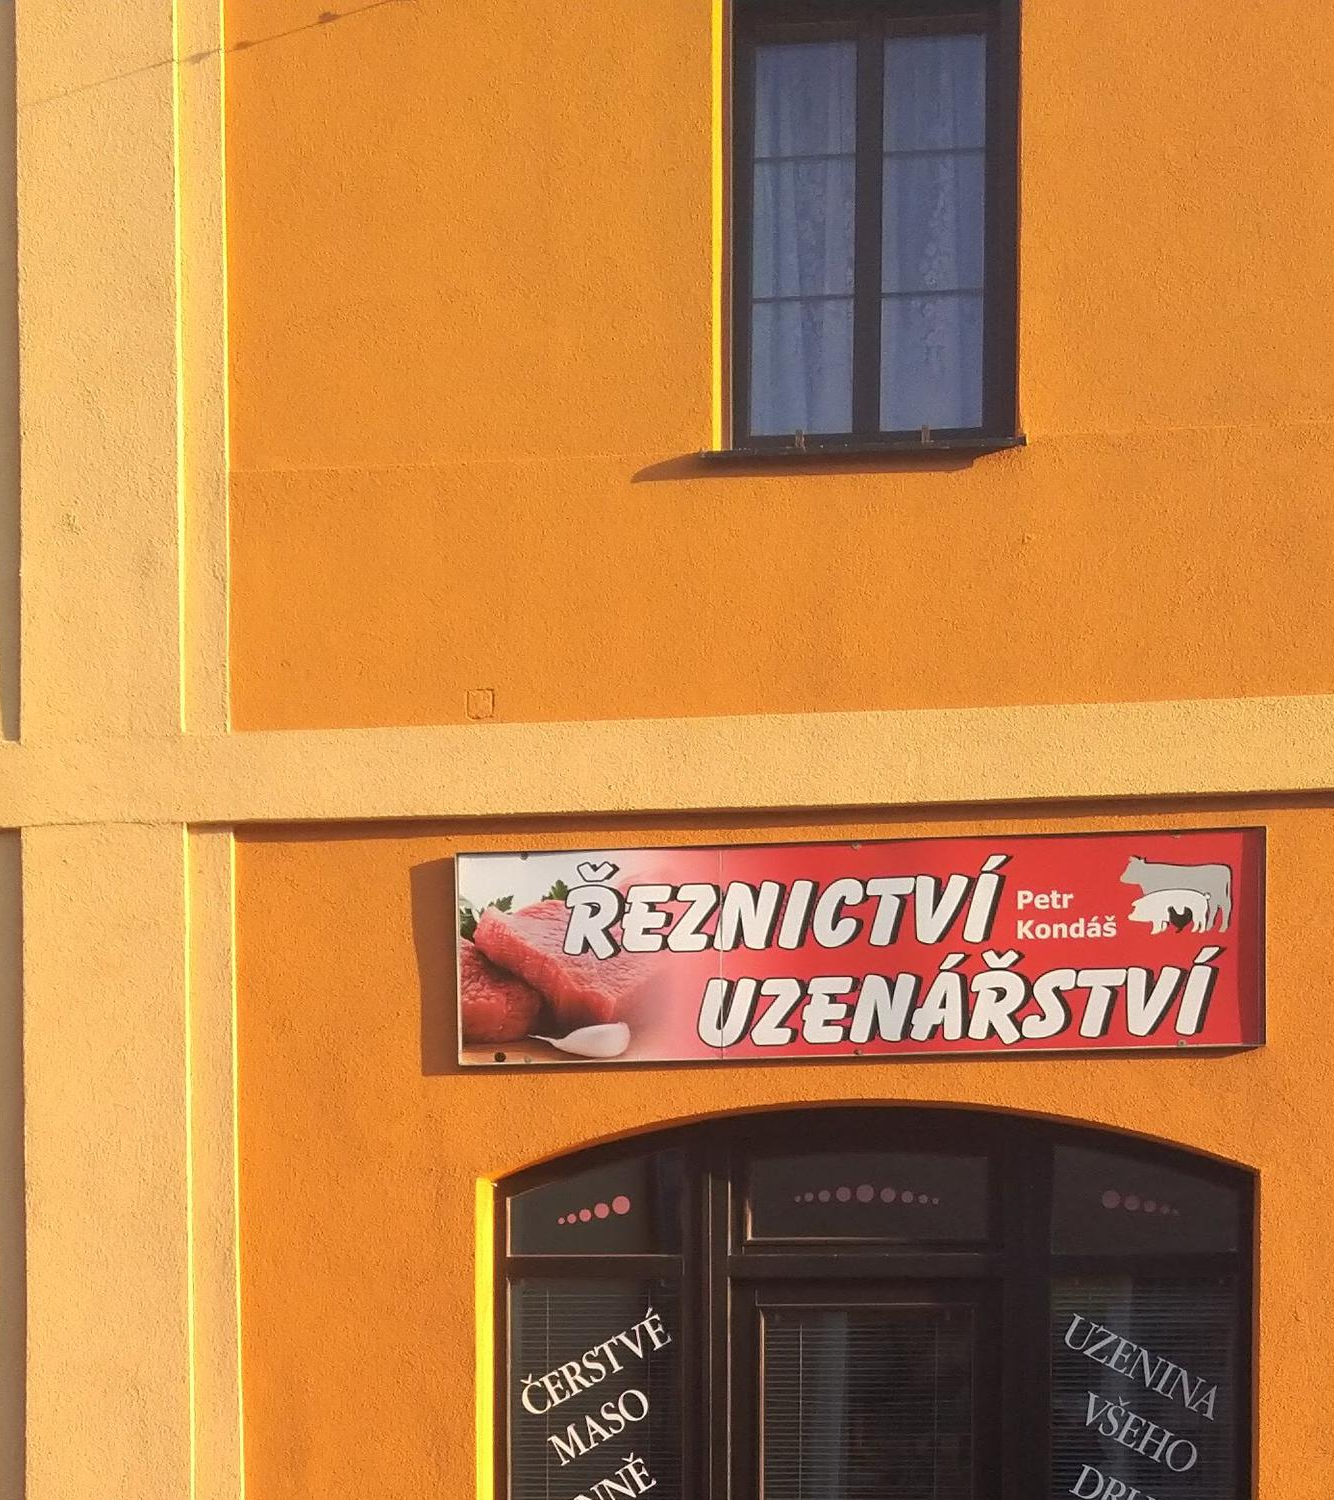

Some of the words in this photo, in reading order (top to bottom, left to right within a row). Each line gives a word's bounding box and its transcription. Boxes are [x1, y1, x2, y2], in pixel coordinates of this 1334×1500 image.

[562, 855, 1013, 961] ŘEZNICTVÍ
[1017, 888, 1075, 910] Petr
[1017, 916, 1117, 940] Kondáš
[697, 945, 1222, 1048] UZENÁŘSTVÍ
[520, 1306, 672, 1415] ČERSTVÉ
[1064, 1313, 1217, 1421] UZENINA
[547, 1389, 649, 1467] MASO
[1085, 1391, 1198, 1472] VŠEHO
